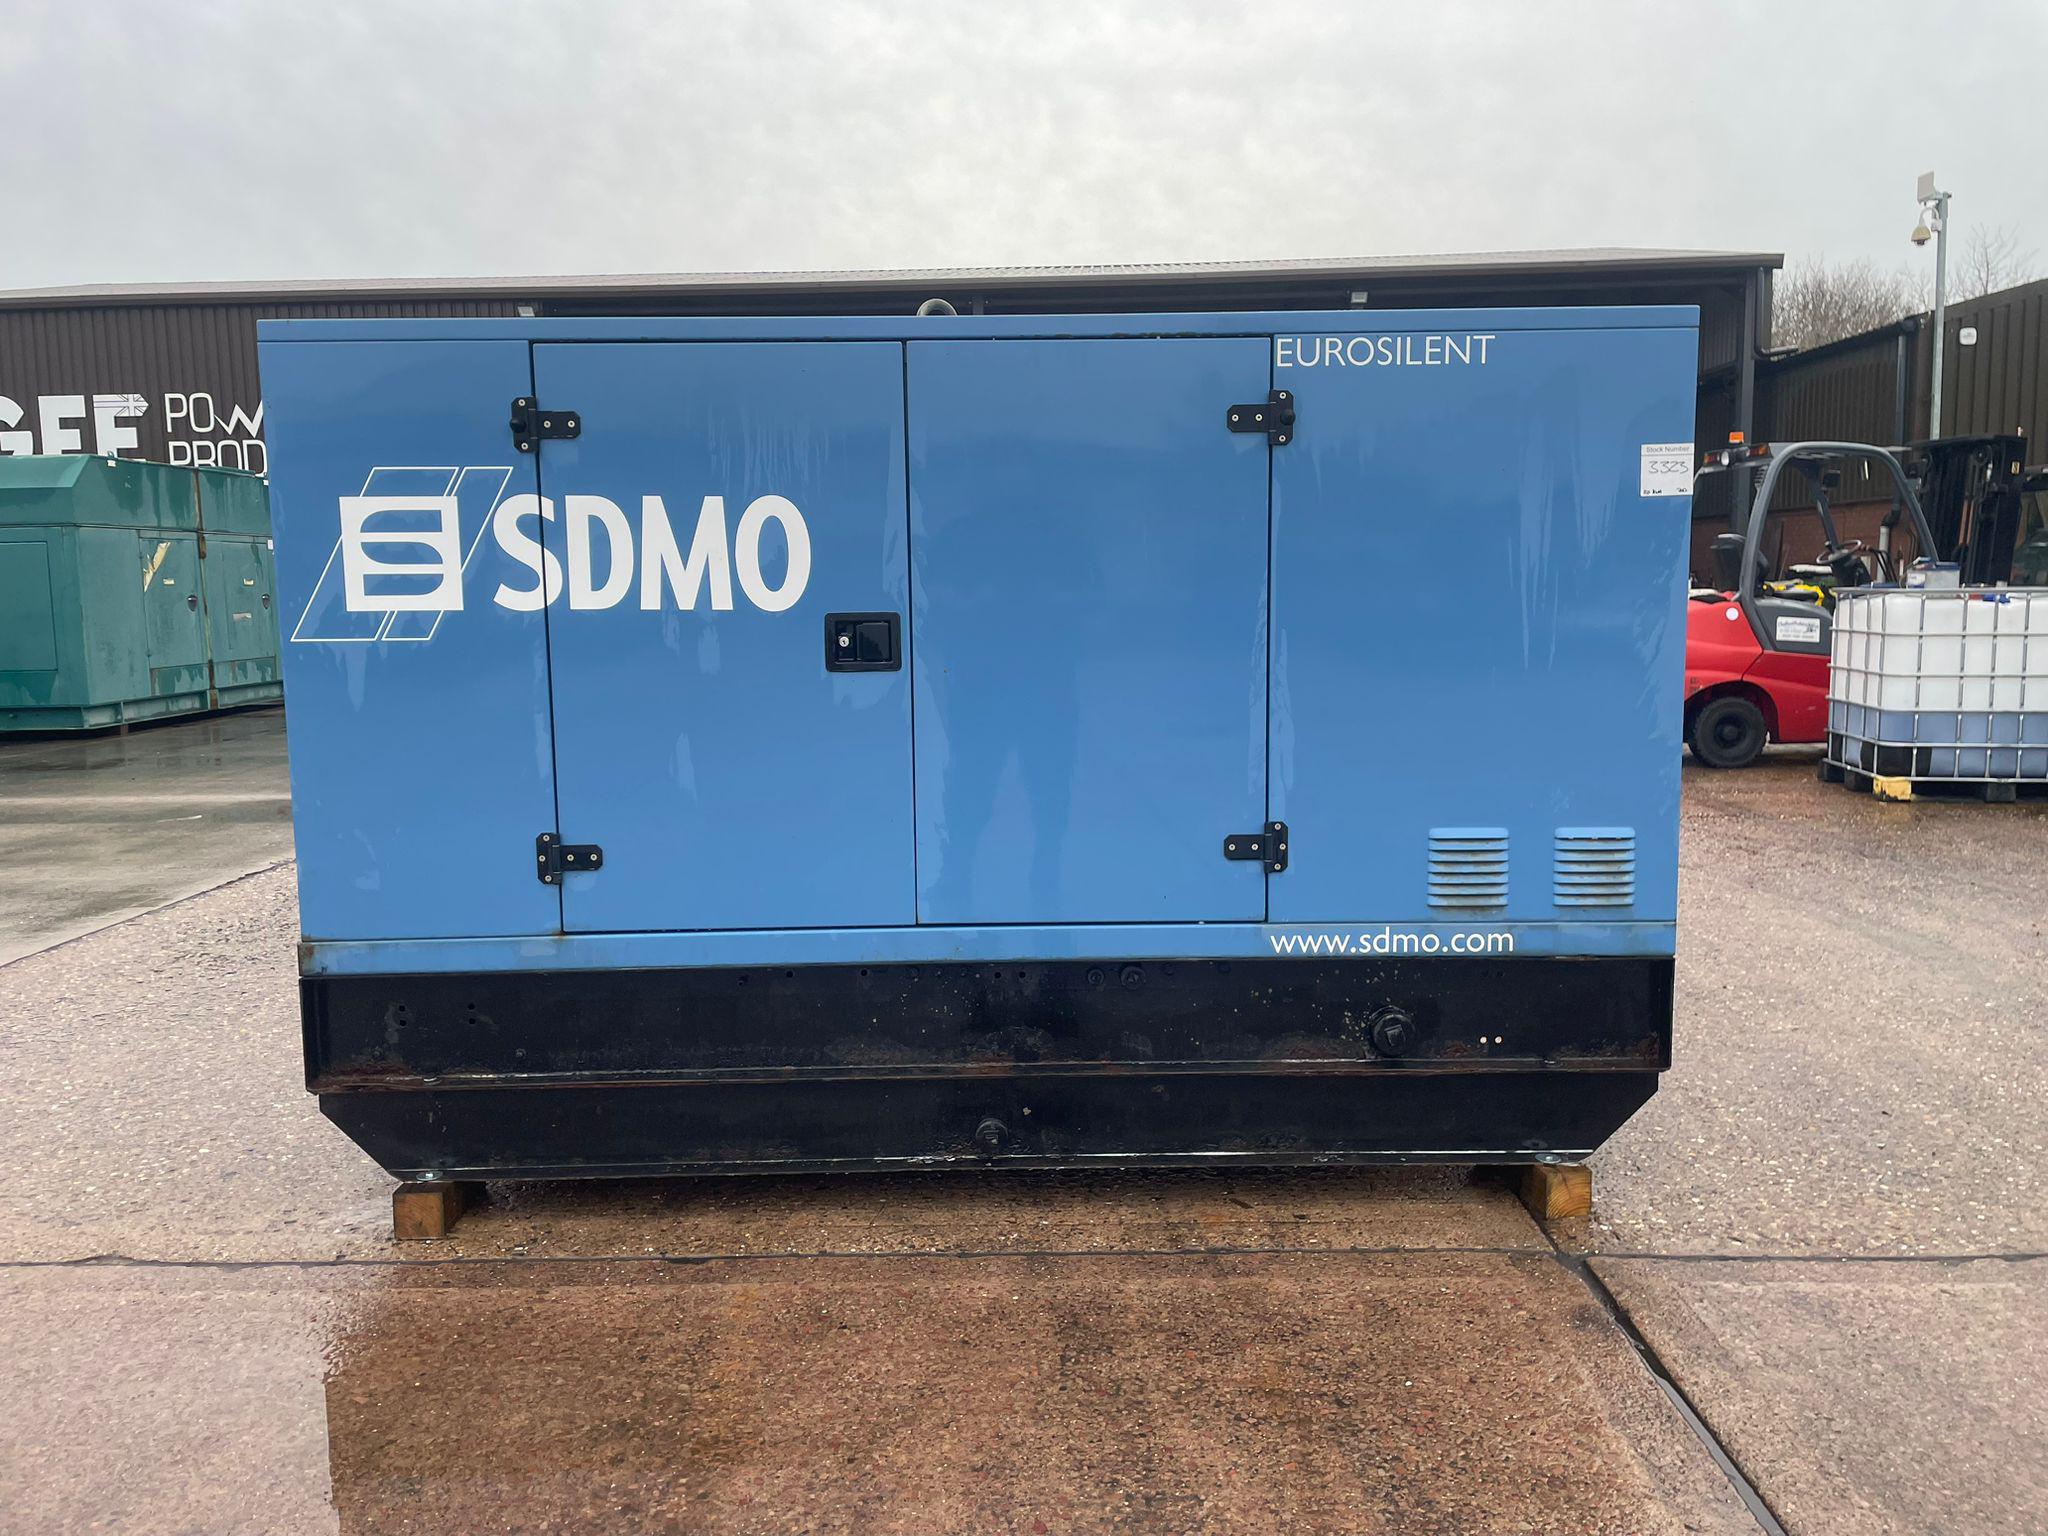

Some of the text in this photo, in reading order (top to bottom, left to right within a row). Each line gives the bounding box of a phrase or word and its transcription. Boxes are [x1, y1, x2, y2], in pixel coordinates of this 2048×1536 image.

[1276, 334, 1496, 368] EUROSILENT
[1664, 445, 1690, 453] Number
[492, 493, 812, 612] SDMO
[1270, 926, 1515, 954] www.sdmo.com
